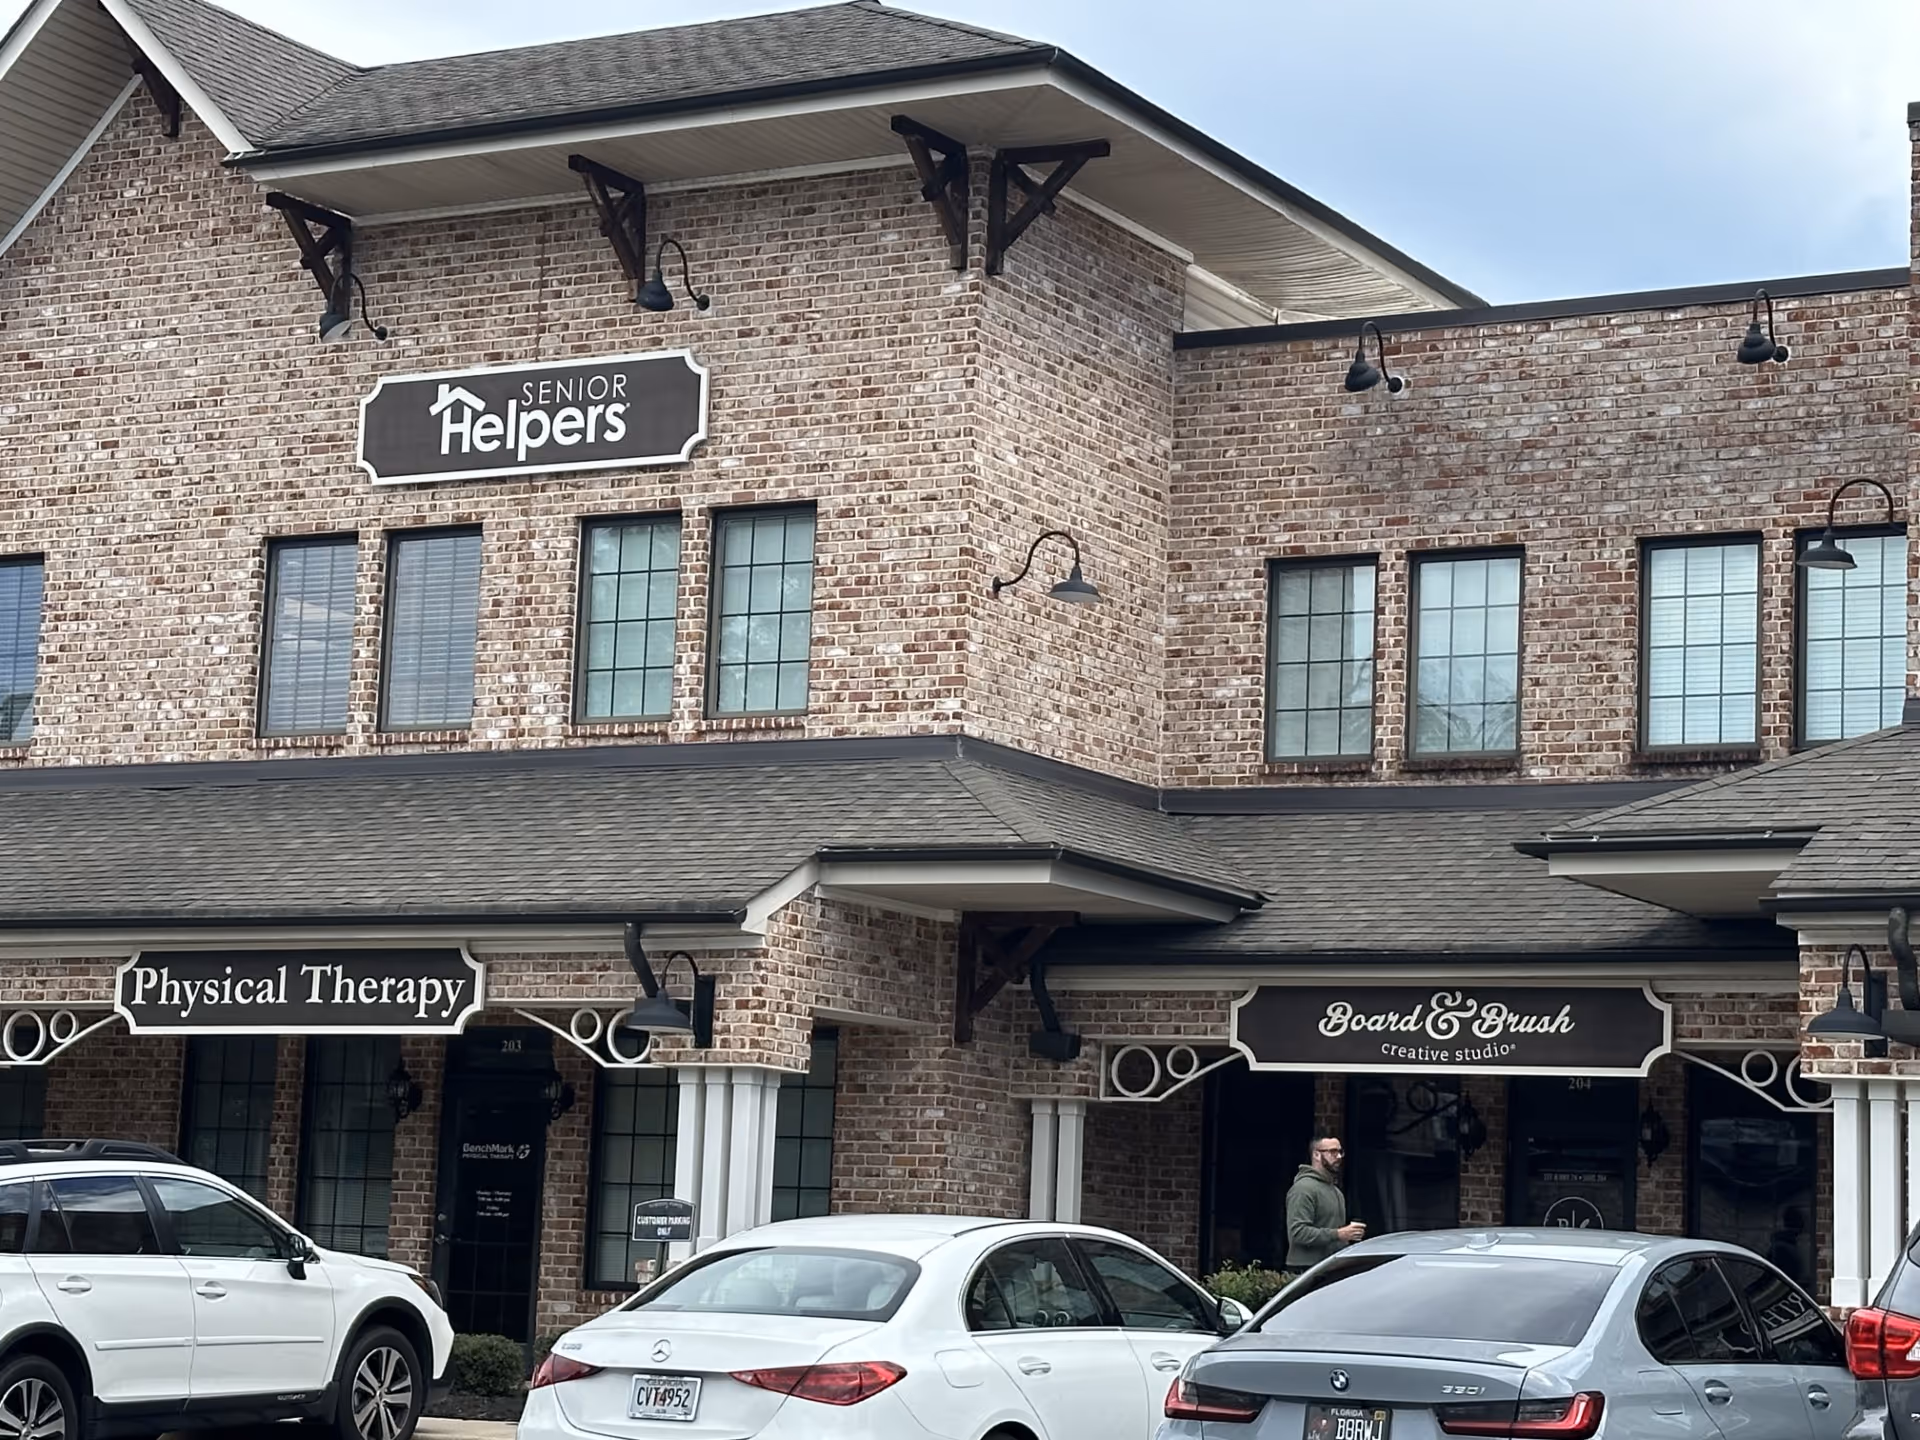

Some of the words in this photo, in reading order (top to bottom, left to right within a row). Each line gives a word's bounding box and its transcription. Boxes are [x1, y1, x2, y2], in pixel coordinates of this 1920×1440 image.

[521, 373, 627, 406] SENIOR
[440, 398, 628, 461] Helpers
[131, 966, 288, 1018] Physical
[300, 963, 466, 1019] Therapy
[1318, 1001, 1424, 1037] Board
[1424, 991, 1477, 1040] &
[1471, 1002, 1575, 1039] Brush
[501, 1039, 522, 1052] 203
[1381, 1042, 1450, 1062] creative
[1567, 1076, 1592, 1090] 204
[462, 1142, 515, 1154] BenchMark
[637, 1386, 691, 1408] CVT4952
[1330, 1408, 1364, 1417] FLORIDA
